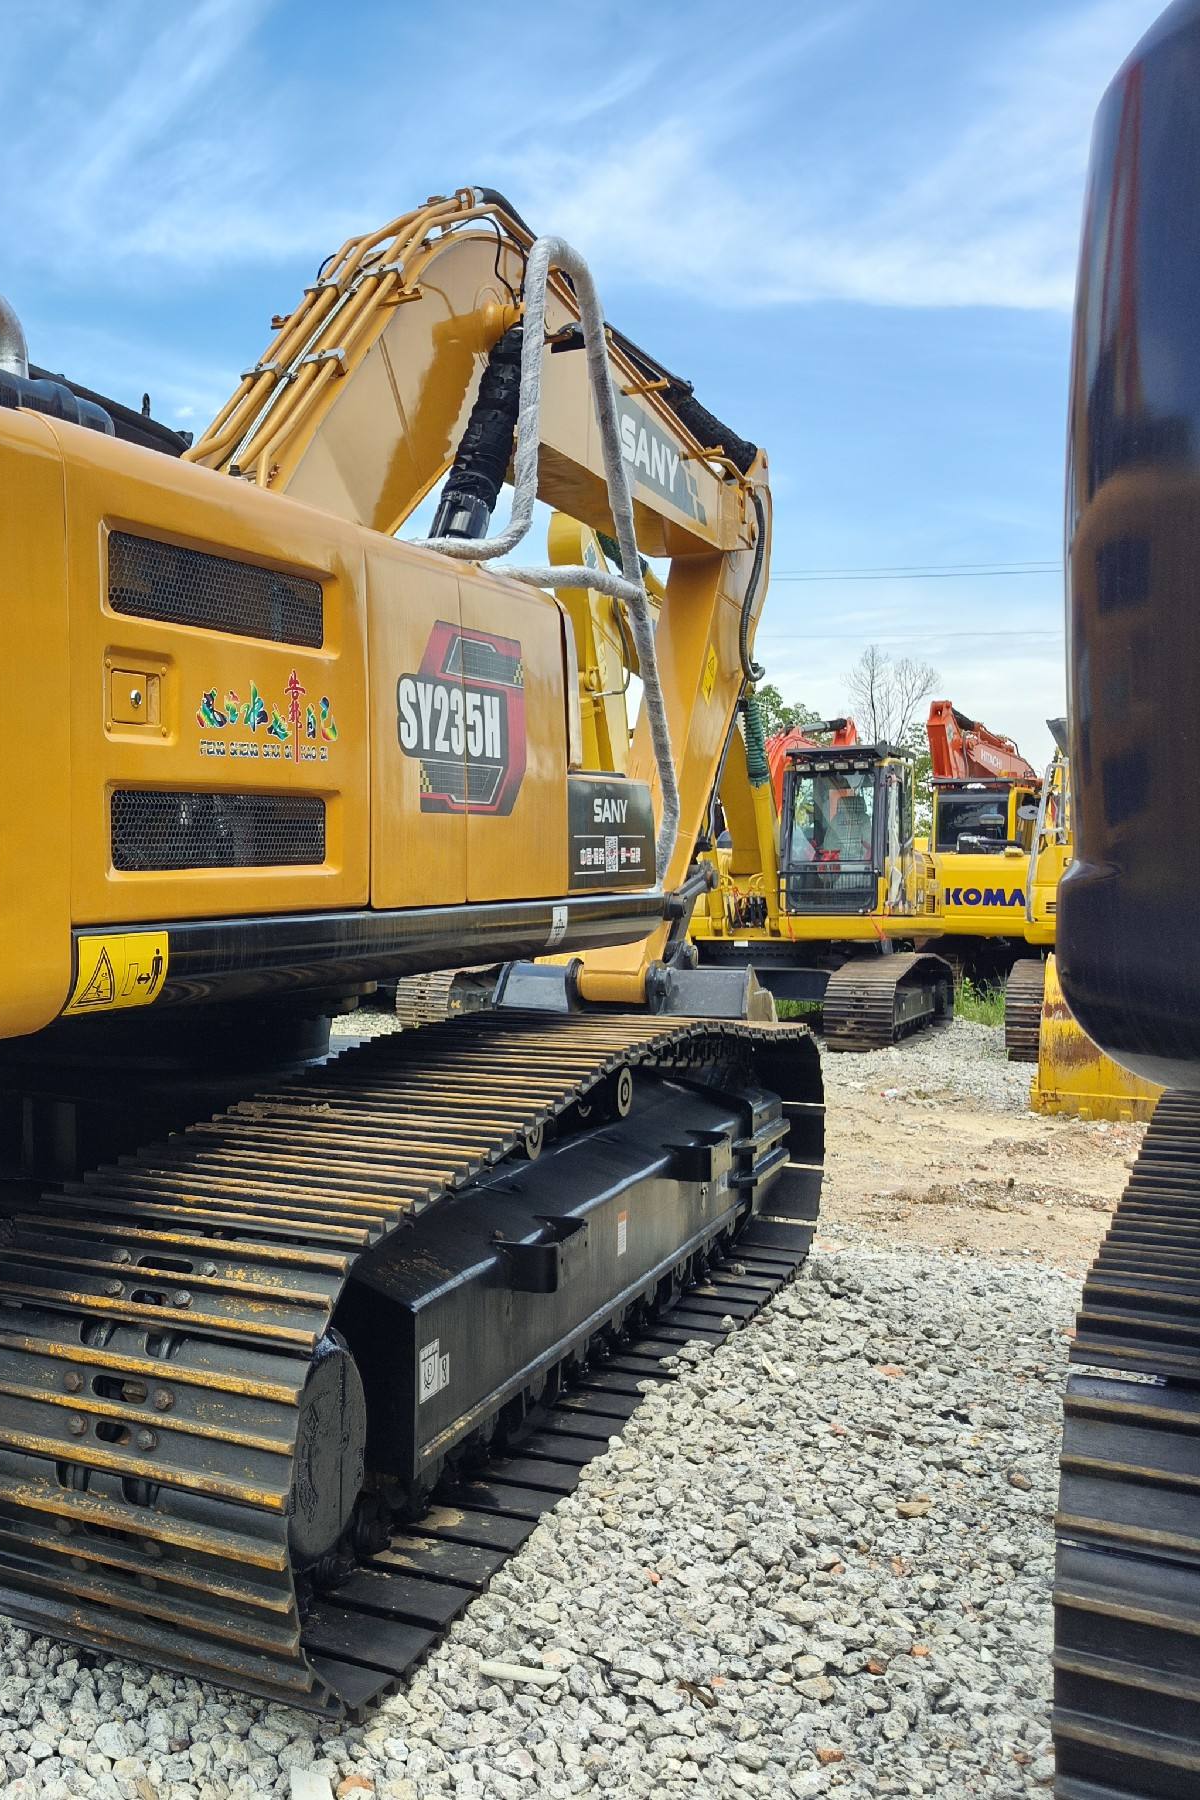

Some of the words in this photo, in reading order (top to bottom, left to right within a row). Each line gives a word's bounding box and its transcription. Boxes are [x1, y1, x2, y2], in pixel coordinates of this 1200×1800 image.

[620, 414, 680, 493] SANY
[399, 678, 502, 759] SY235H
[593, 798, 628, 823] SANY
